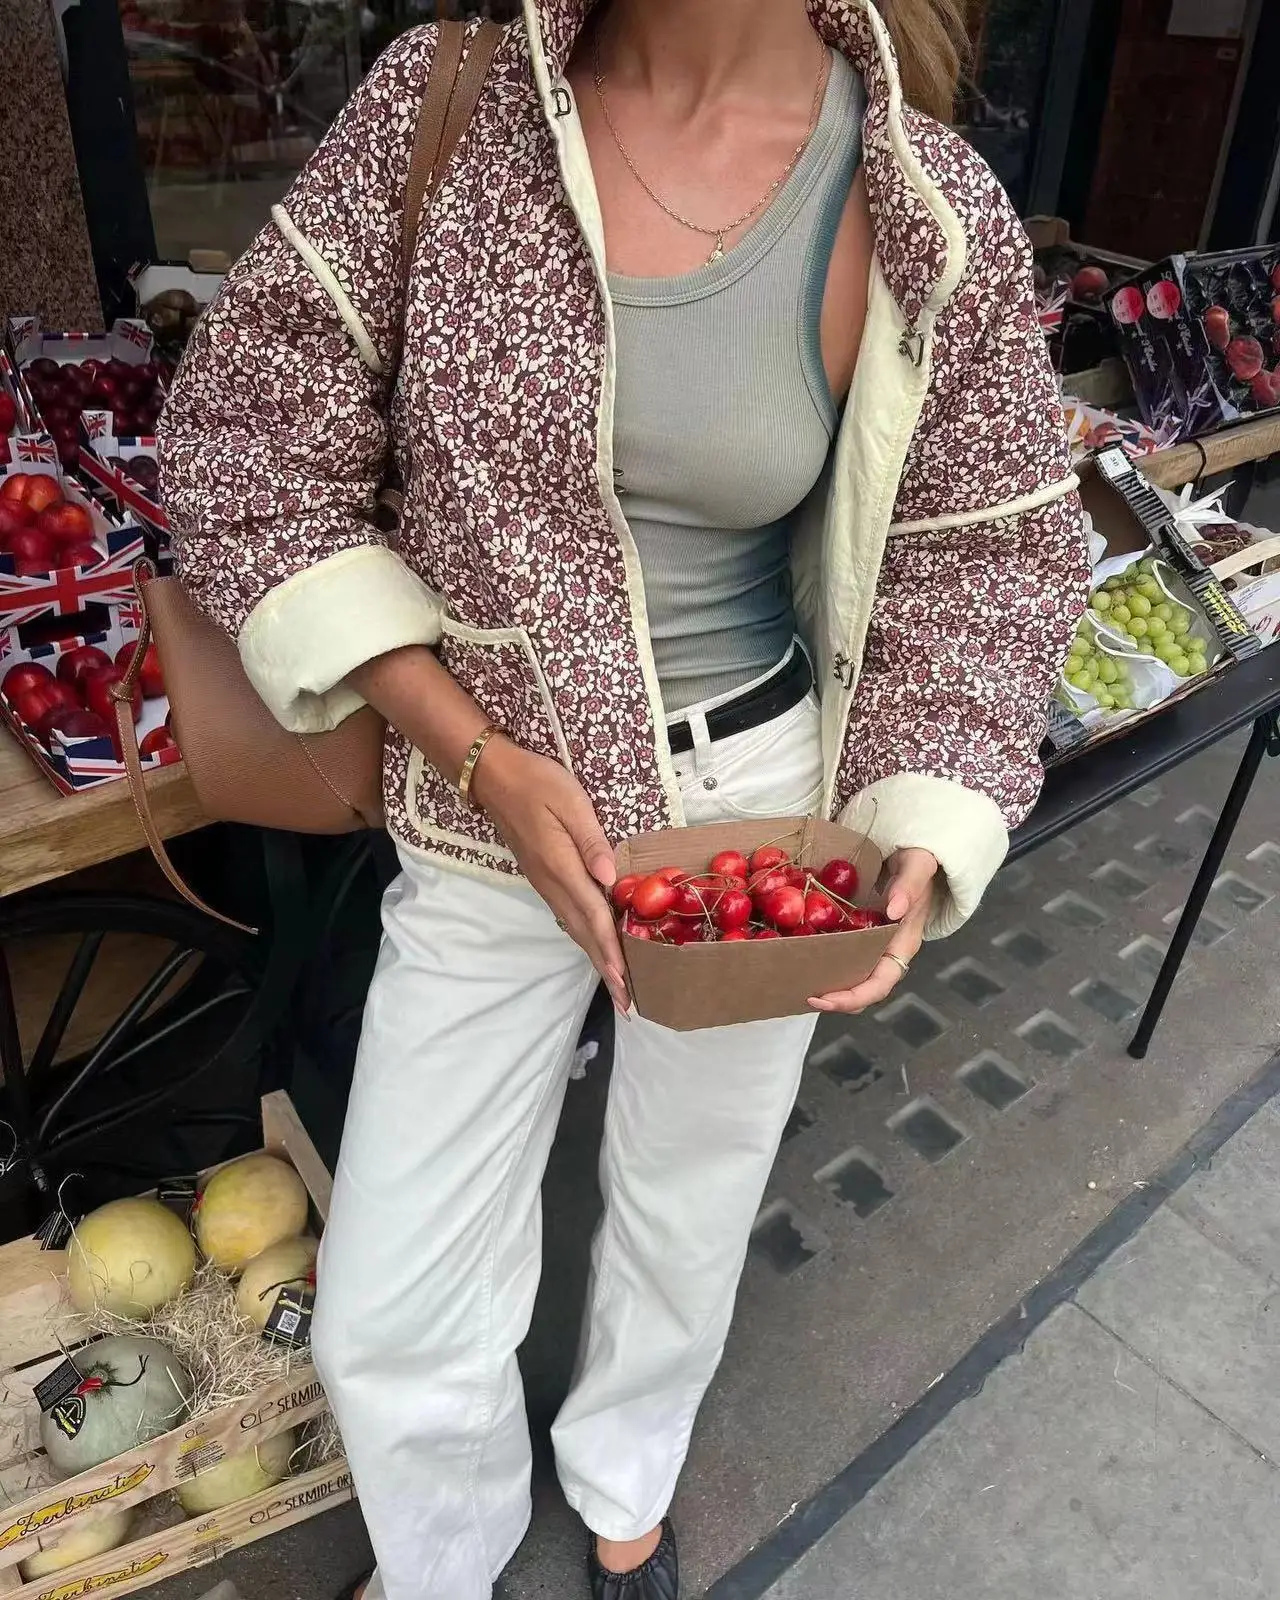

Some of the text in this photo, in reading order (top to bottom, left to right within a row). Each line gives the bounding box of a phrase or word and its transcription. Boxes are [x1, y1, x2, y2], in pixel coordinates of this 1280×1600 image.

[277, 1381, 327, 1413] SERMID
[16, 1474, 131, 1537] Zerbinati
[284, 1480, 334, 1511] SERMIDE
